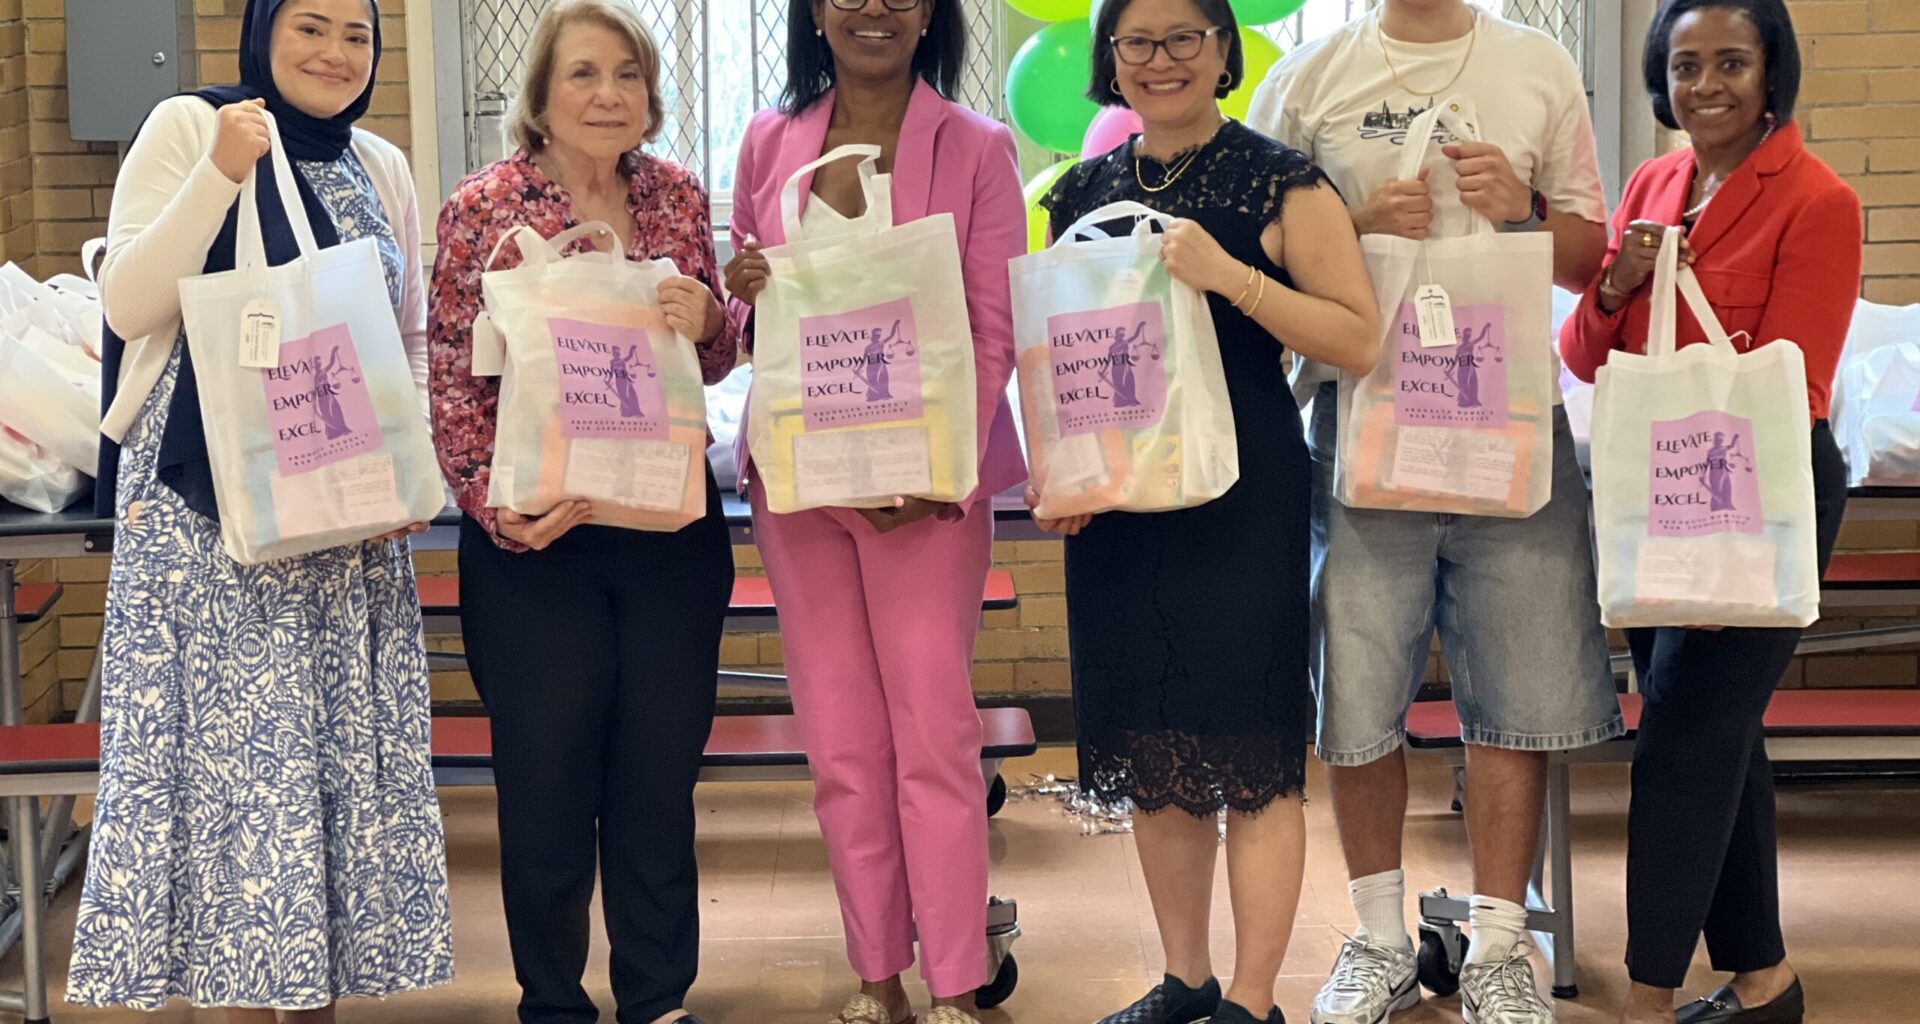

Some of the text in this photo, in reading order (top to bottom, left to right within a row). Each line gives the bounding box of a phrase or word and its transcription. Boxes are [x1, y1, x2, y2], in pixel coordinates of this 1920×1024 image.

[557, 336, 611, 354] ELEVATE
[805, 329, 870, 348] ELEVATE
[1053, 327, 1114, 348] ELEVATE
[267, 357, 315, 380] ELEVA
[807, 352, 891, 373] EMPOWER
[1056, 353, 1137, 376] EMPOWER
[1402, 350, 1480, 368] EMPOWER
[562, 363, 635, 384] EMPOWER
[273, 383, 340, 411] EMPOER
[807, 382, 862, 398] EXCEL
[1060, 386, 1109, 405] EXCEL
[1401, 378, 1454, 398] EXCEL
[565, 390, 616, 408] EXCEL
[1656, 431, 1712, 454] ELEVATE
[1655, 458, 1733, 480] EMPOWER
[1655, 492, 1707, 507] EXCEL
